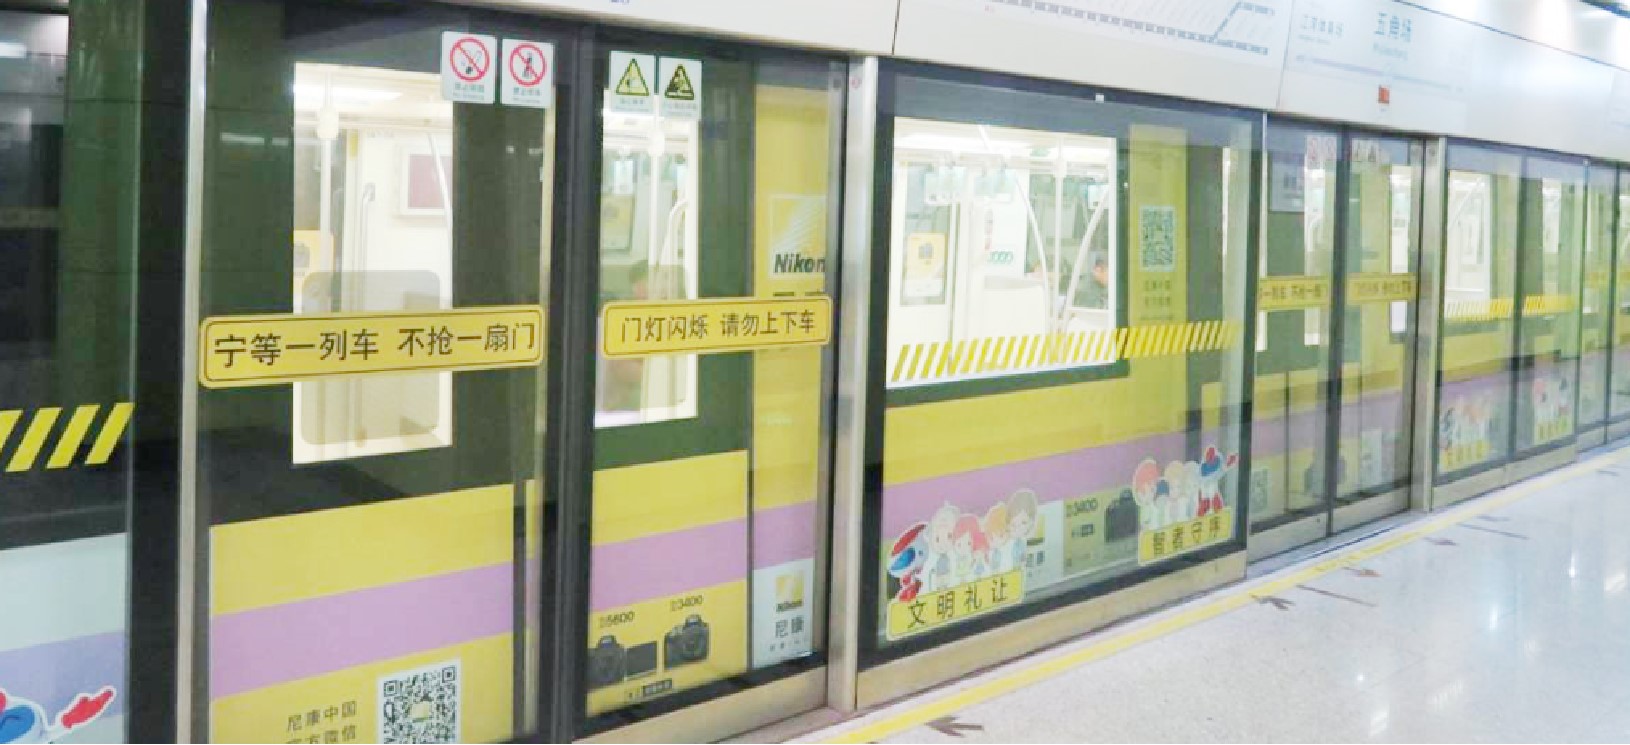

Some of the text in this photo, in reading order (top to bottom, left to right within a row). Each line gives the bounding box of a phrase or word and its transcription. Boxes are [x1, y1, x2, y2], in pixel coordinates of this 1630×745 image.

[214, 322, 536, 368] 宁等一列车 不抢一扇门
[621, 309, 816, 343] 门灯闪烁 请勿上下车
[908, 577, 1009, 628] 文明礼让
